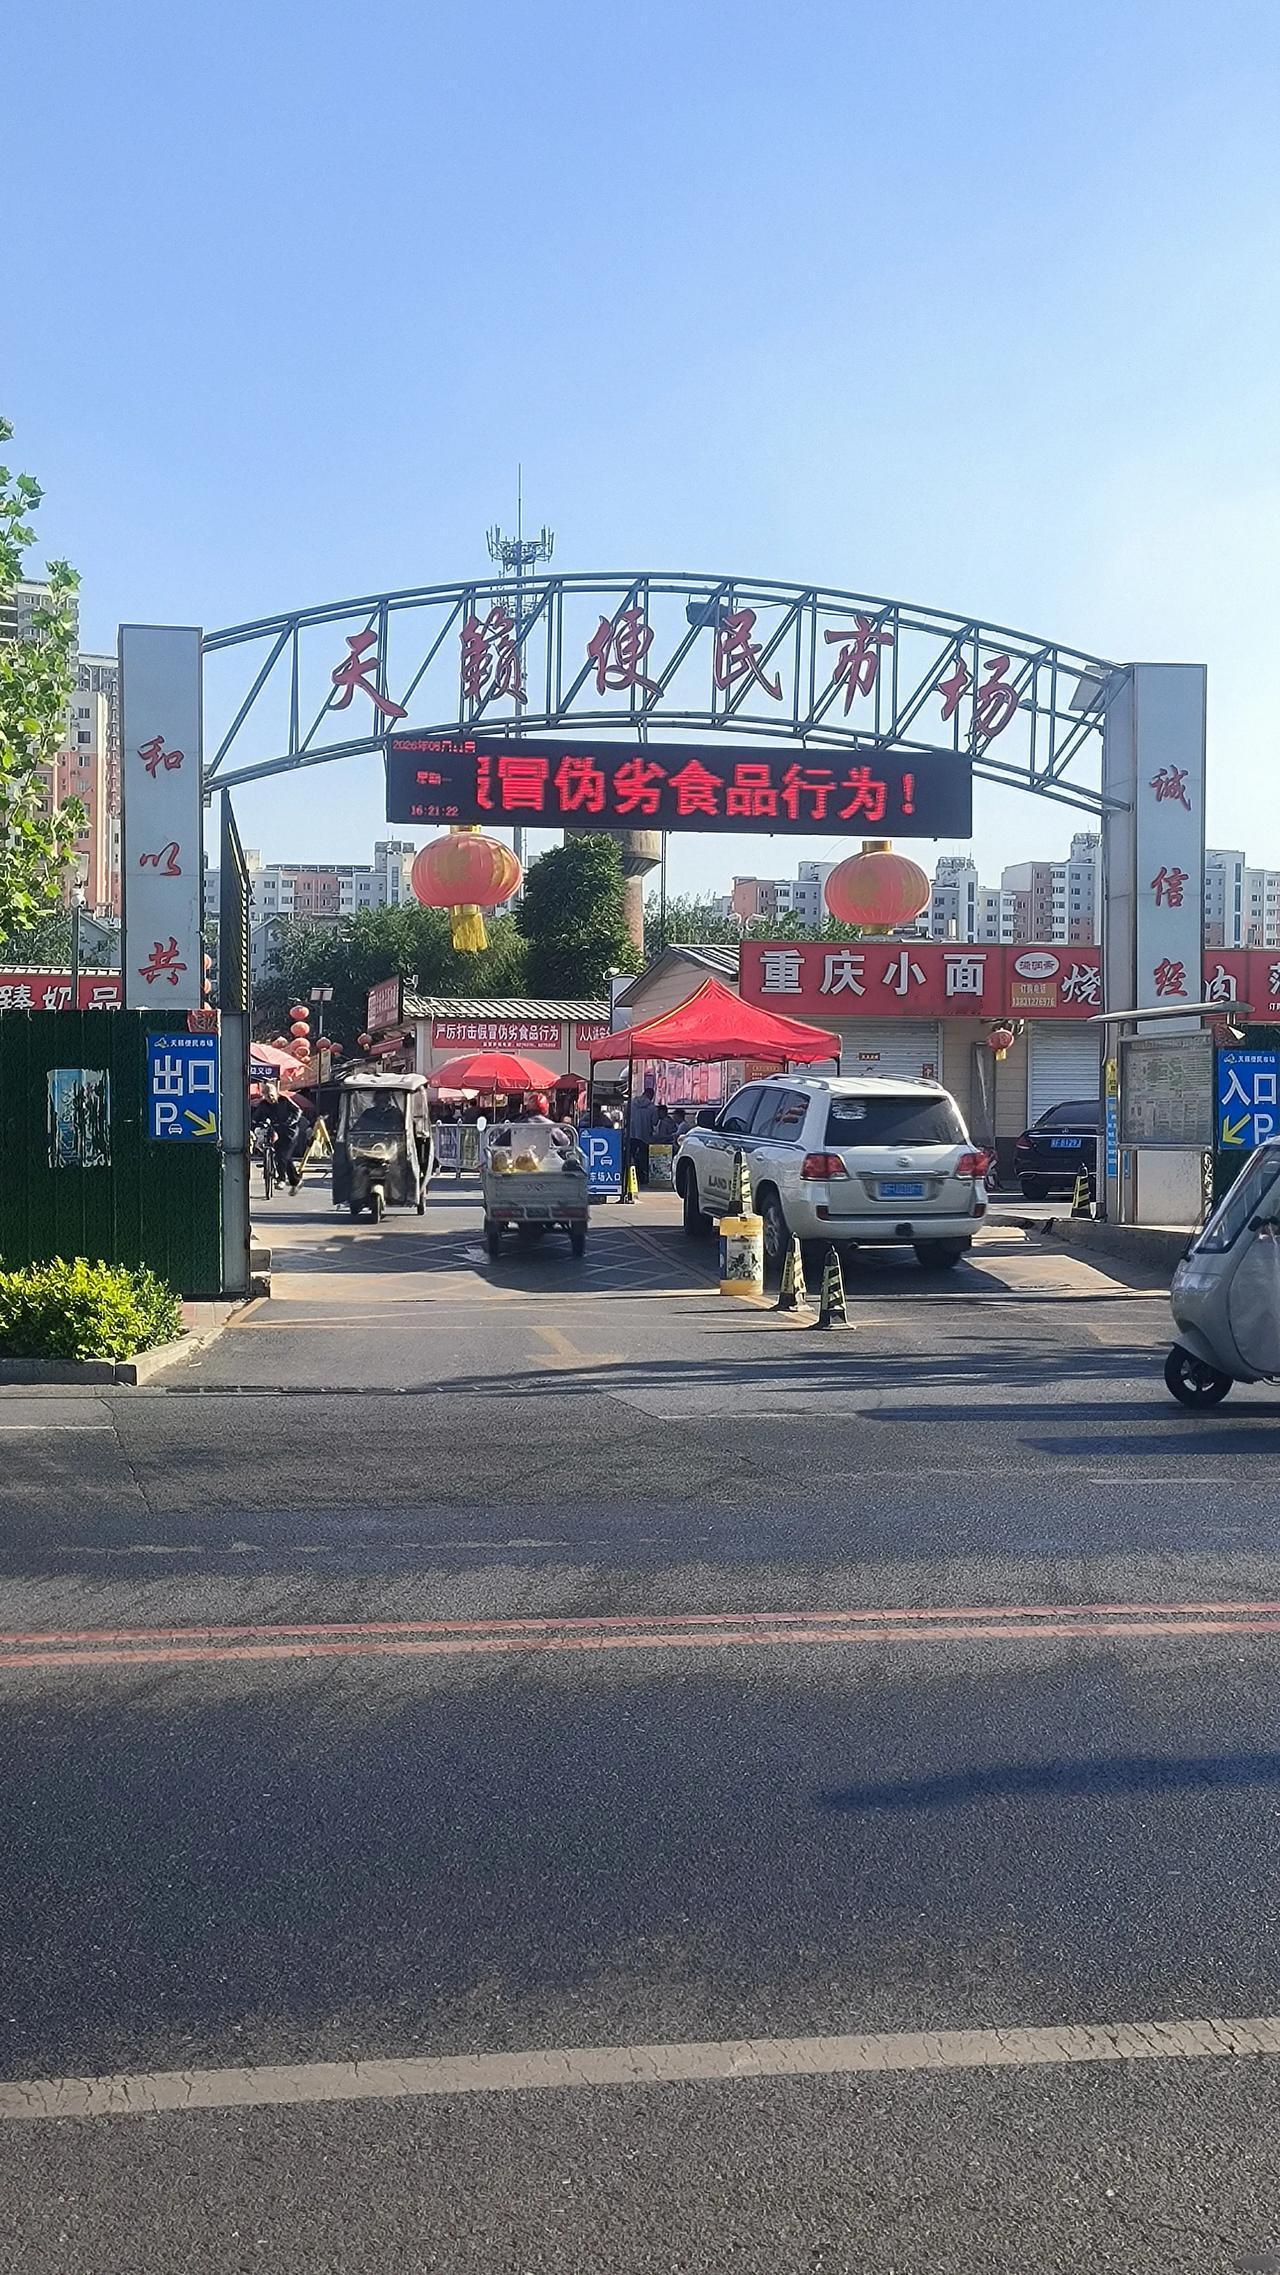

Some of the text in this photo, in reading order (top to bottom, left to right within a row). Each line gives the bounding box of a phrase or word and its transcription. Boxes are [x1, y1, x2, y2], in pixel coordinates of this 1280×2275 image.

[331, 606, 1020, 738] 天籁便民市场
[410, 805, 459, 817] 16:21:22
[759, 949, 988, 996] 重庆小面
[435, 1023, 559, 1040] 严厉打击假冒伪劣食品行为
[153, 1055, 215, 1096] 出口
[1221, 1069, 1277, 1106] 入口
[155, 1102, 178, 1136] P
[1254, 1113, 1274, 1144] P
[590, 1138, 609, 1167] P
